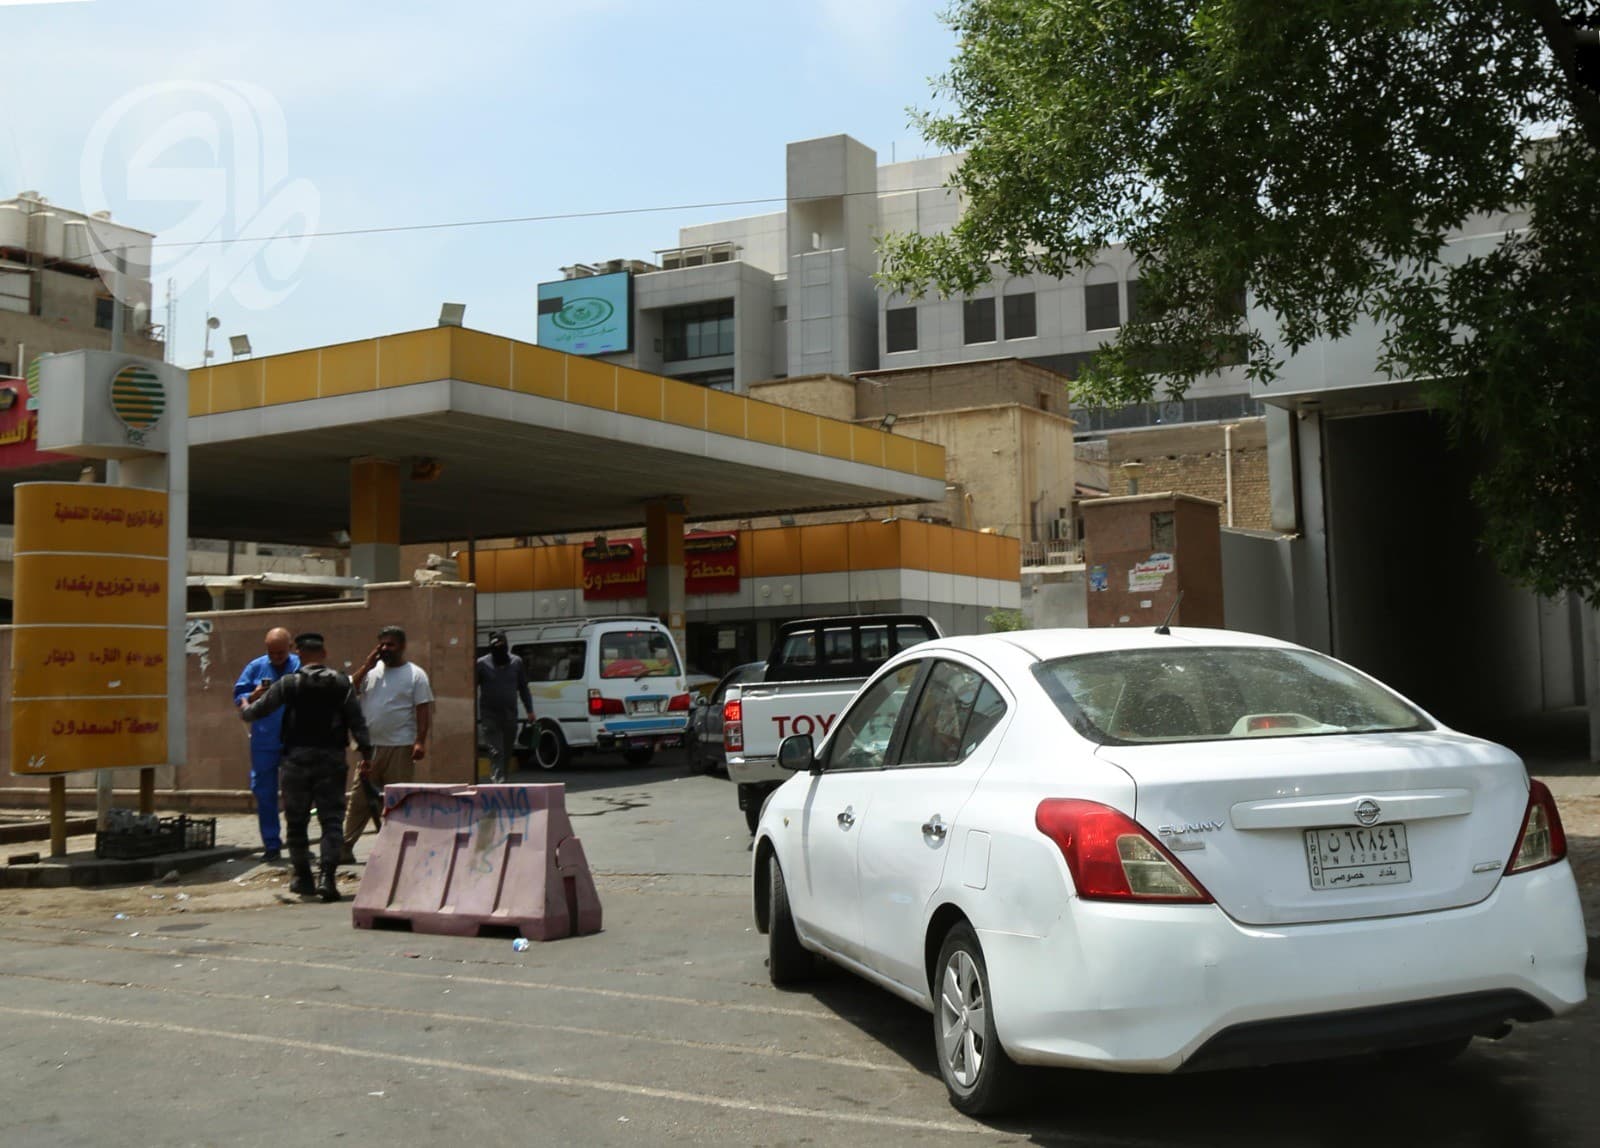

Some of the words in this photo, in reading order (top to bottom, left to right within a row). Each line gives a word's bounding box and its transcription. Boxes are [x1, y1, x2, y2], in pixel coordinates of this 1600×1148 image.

[584, 566, 645, 589] السعدون
[691, 560, 736, 578] محطة
[55, 574, 94, 597] بغداد
[95, 577, 134, 598] توزيع
[51, 719, 122, 735] السعدون
[123, 717, 159, 734] محطة
[772, 714, 836, 738] TOY
[1159, 821, 1225, 836] SUNNY
[1310, 831, 1320, 876] IRAQ
[1330, 872, 1365, 885] خصوصي
